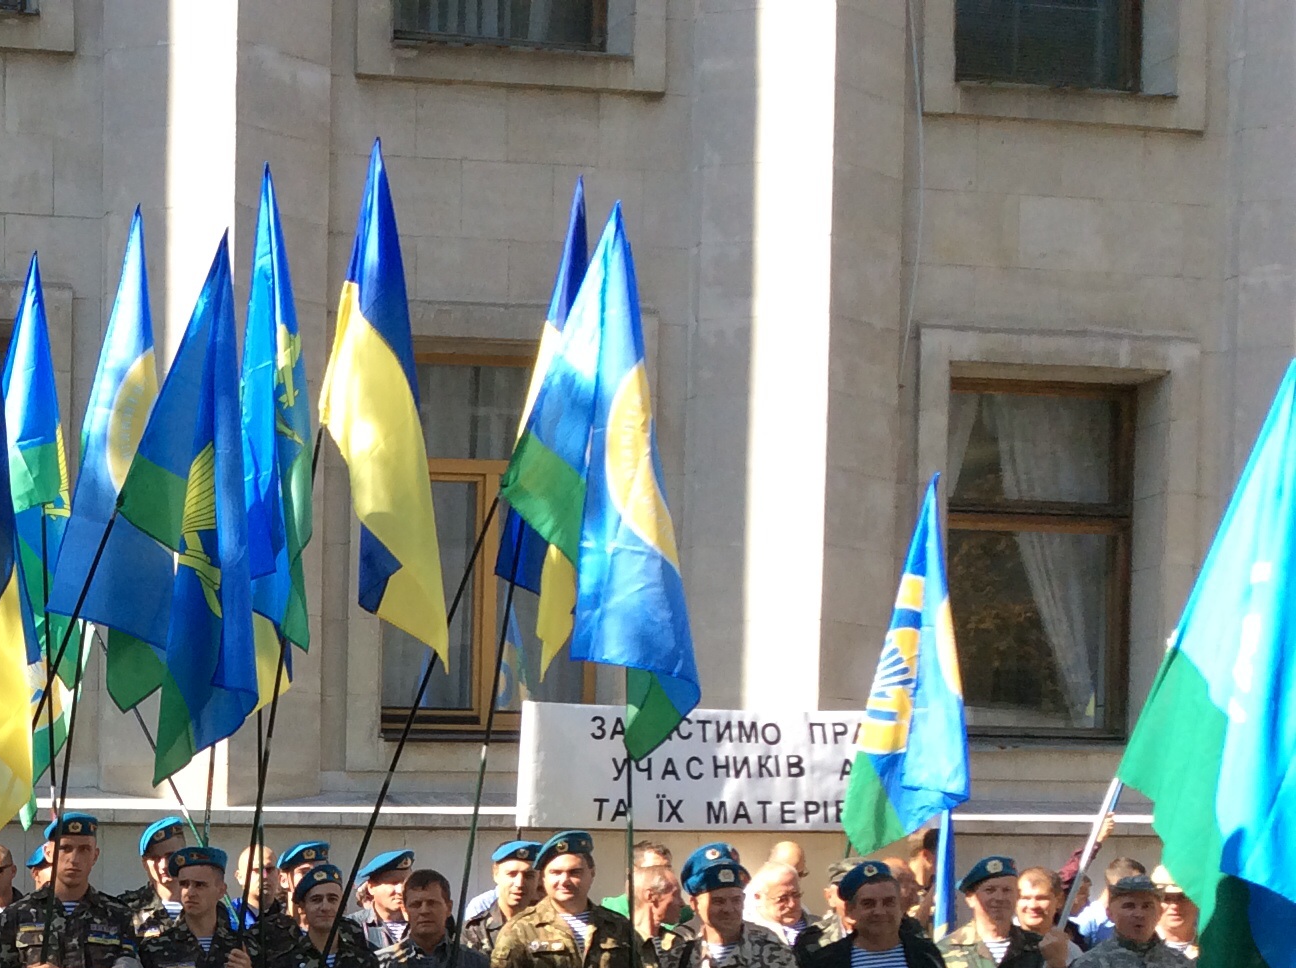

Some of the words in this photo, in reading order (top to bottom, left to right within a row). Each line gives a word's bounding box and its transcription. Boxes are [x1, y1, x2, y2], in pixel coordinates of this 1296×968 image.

[590, 715, 782, 746] ЗАСТИМО
[809, 722, 862, 745] ПР
[612, 754, 805, 781] УЧАСНИКІВ
[593, 798, 630, 822] ТА
[656, 794, 685, 823] ЇХ
